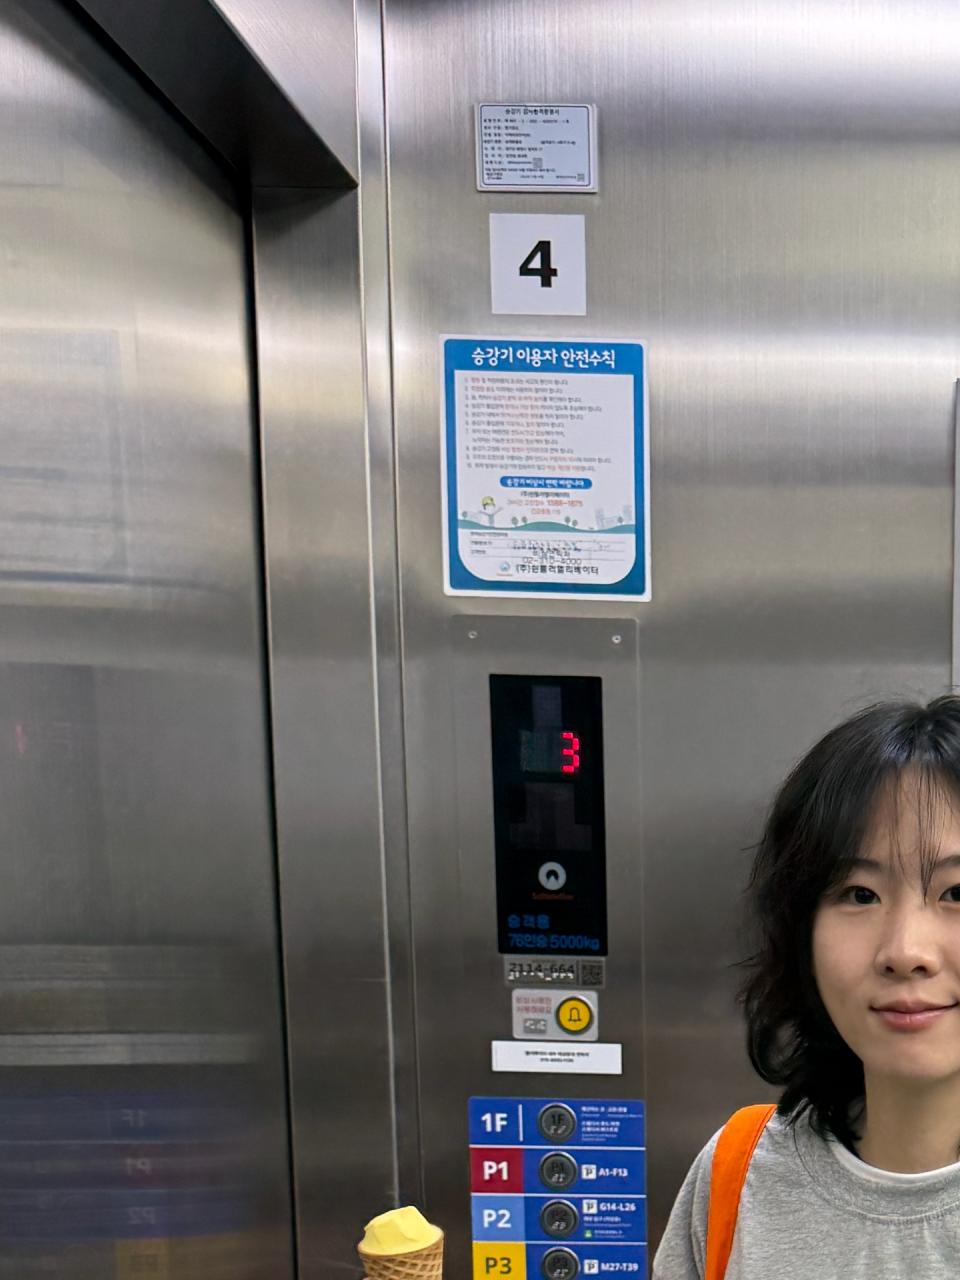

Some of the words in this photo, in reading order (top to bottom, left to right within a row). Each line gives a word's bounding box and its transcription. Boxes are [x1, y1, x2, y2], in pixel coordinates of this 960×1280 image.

[518, 240, 558, 288] 4
[472, 346, 514, 366] 승강기
[516, 347, 558, 367] 이용자
[560, 348, 616, 369] 안전수칙
[561, 731, 580, 774] 3
[481, 1112, 508, 1132] 1F
[483, 1160, 509, 1181] P1
[598, 1167, 628, 1177] A1-F13
[599, 1202, 637, 1212] G14-L26
[483, 1209, 512, 1228] P2
[485, 1257, 512, 1275] P3
[601, 1259, 639, 1272] M27-T39
